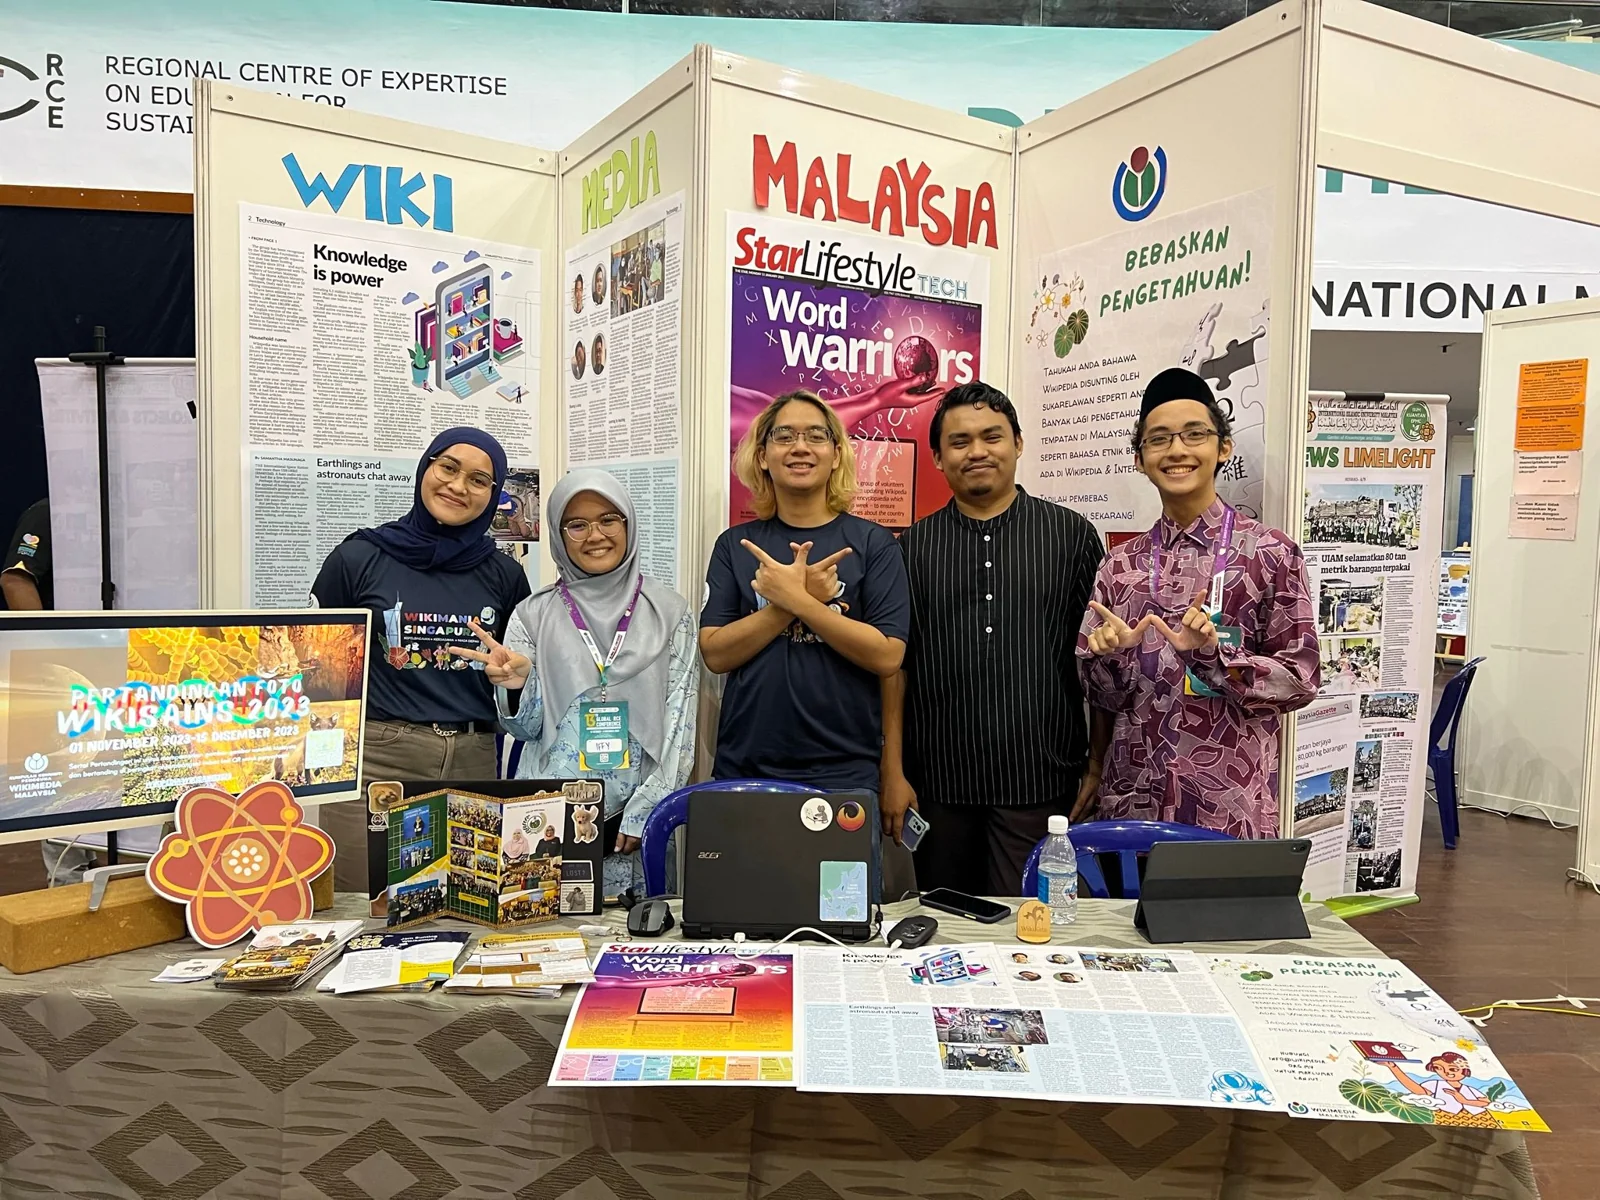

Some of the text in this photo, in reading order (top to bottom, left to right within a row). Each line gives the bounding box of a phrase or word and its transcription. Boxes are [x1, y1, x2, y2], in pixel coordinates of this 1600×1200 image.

[105, 55, 508, 96] REGIONAL CENTRE OF EXPERTISE
[105, 84, 147, 104] ON
[105, 112, 193, 135] SUSTAI
[582, 130, 661, 235] MEDIA
[753, 134, 999, 249] MALAYSIA
[281, 152, 453, 233] WIKI
[256, 216, 286, 228] Technology
[313, 243, 408, 274] Knowledge
[1125, 225, 1230, 273] BEBASKAN
[313, 264, 384, 289] is power
[1099, 249, 1251, 318] PENGETAHUAN!
[917, 273, 968, 300] TECH
[762, 286, 847, 330] Word
[1044, 353, 1137, 378] TAHUKAH ANDA BAHAWA
[1042, 371, 1140, 395] WIKIPEDIA DISUNTING OLEH
[1042, 395, 1095, 412] SUKARELAWAN
[1096, 392, 1128, 404] SEPERTI
[1041, 408, 1142, 429] BANYAK LAGI PENGETAHUA
[1041, 432, 1079, 446] TEMPATAN
[1080, 432, 1088, 441] DI
[316, 457, 382, 471] Earthlings and
[1040, 451, 1068, 462] SEPERTI
[1069, 449, 1100, 460] BAHASA
[1101, 448, 1124, 458] ETNIK
[1343, 448, 1436, 469] LIMELIGHT
[316, 470, 412, 484] astronauts chat away
[1039, 464, 1138, 479] ADA DI WIKIPEDIA & INTER
[1069, 493, 1109, 503] PEMBEBAS
[1090, 510, 1135, 521] SEKARANG!
[1321, 552, 1407, 563] UIAM selamatkan 80 tan
[1321, 562, 1411, 574] metrik barangan terpakai
[404, 612, 482, 626] WIKIMANIA
[70, 675, 302, 707] PERTANDINGAN FOTO
[56, 696, 311, 736] WIKISAINS 2023
[1297, 706, 1337, 721] alaysiaGazette
[68, 740, 83, 755] 01
[86, 736, 160, 754] NOVEMBER
[211, 728, 271, 743] DISEMBER
[273, 725, 300, 738] 2023
[1311, 737, 1332, 750] berjaya
[1297, 743, 1348, 761] 80,000 kg barangan
[9, 780, 62, 792] WIKIMEDIA
[14, 788, 57, 799] MALAYSIA
[697, 850, 722, 860] acer
[621, 955, 684, 965] Word
[1293, 959, 1377, 969] BEBASKAN
[1279, 968, 1403, 979] PENGETAHUAN!
